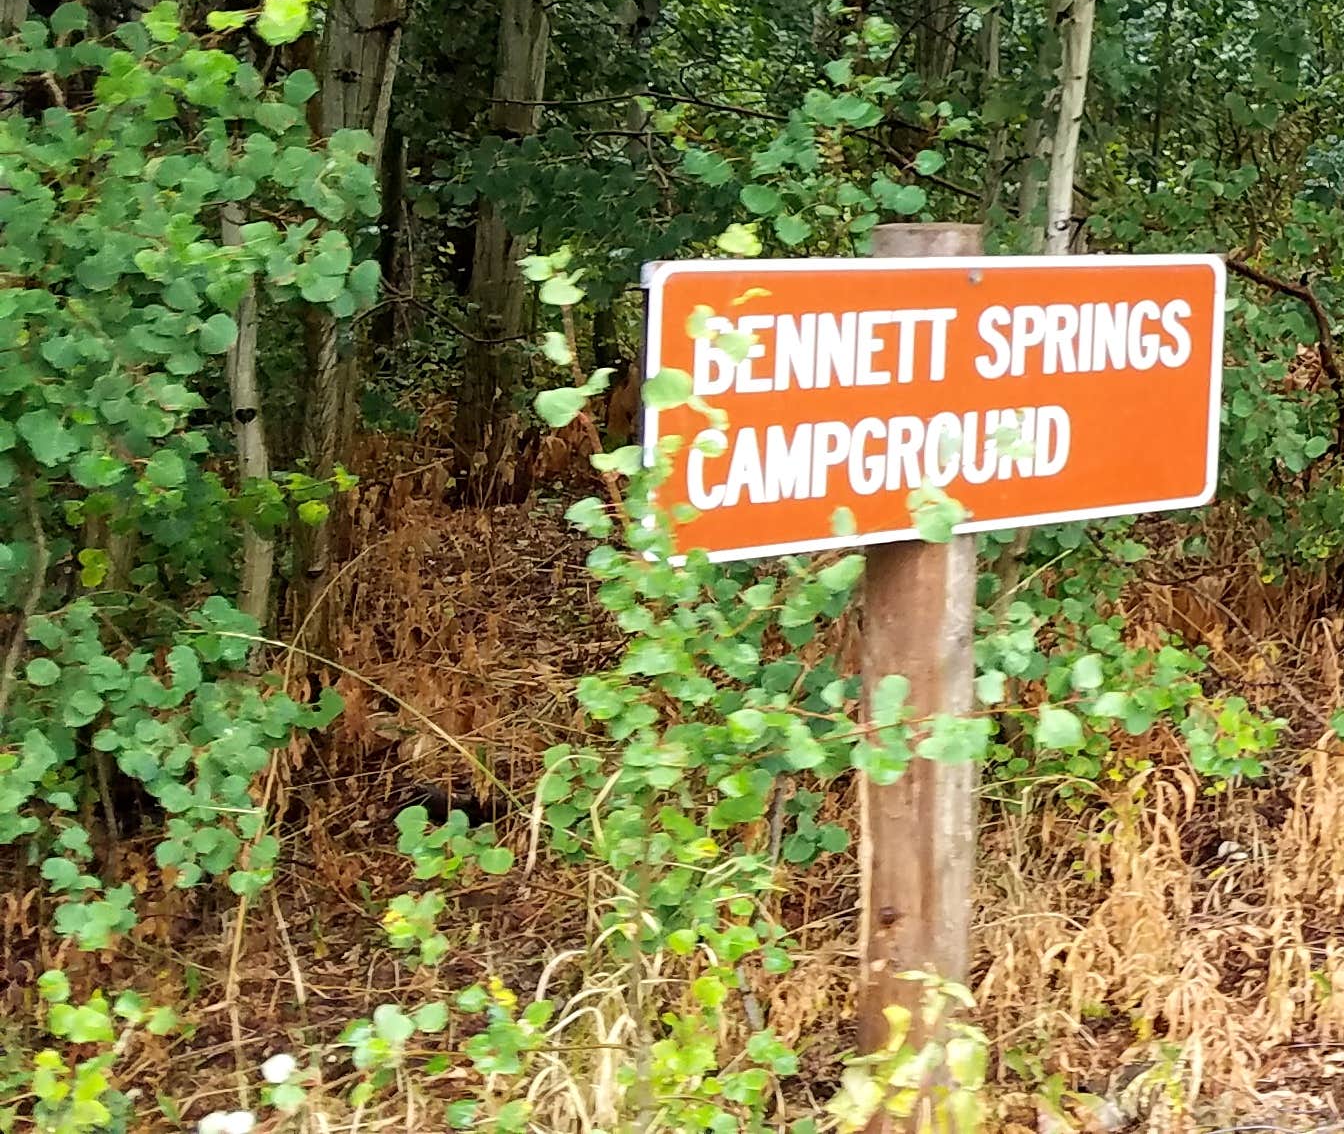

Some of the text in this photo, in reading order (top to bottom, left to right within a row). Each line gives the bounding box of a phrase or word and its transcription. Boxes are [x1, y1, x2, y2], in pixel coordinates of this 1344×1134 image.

[693, 299, 1191, 397] BENNETT SPRINGS
[687, 405, 1071, 510] CAMPGROUND
